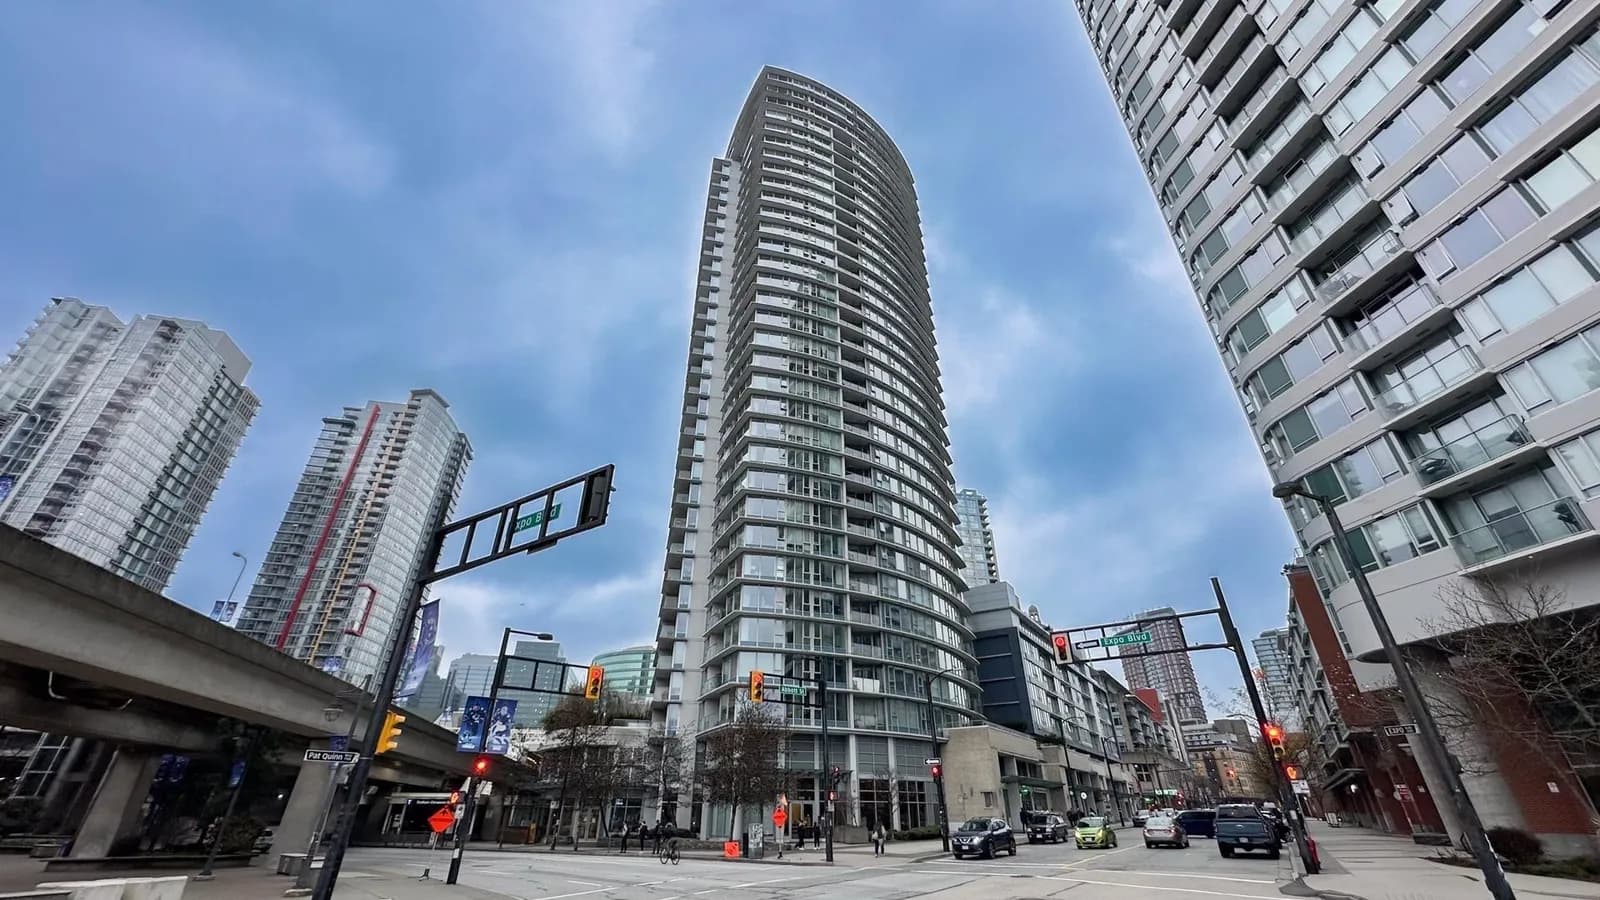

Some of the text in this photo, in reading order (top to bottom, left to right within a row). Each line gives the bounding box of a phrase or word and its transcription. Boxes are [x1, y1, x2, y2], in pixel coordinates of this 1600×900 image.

[515, 517, 531, 531] xpo
[1104, 632, 1147, 645] Expo Blvd
[308, 751, 321, 759] Pat
